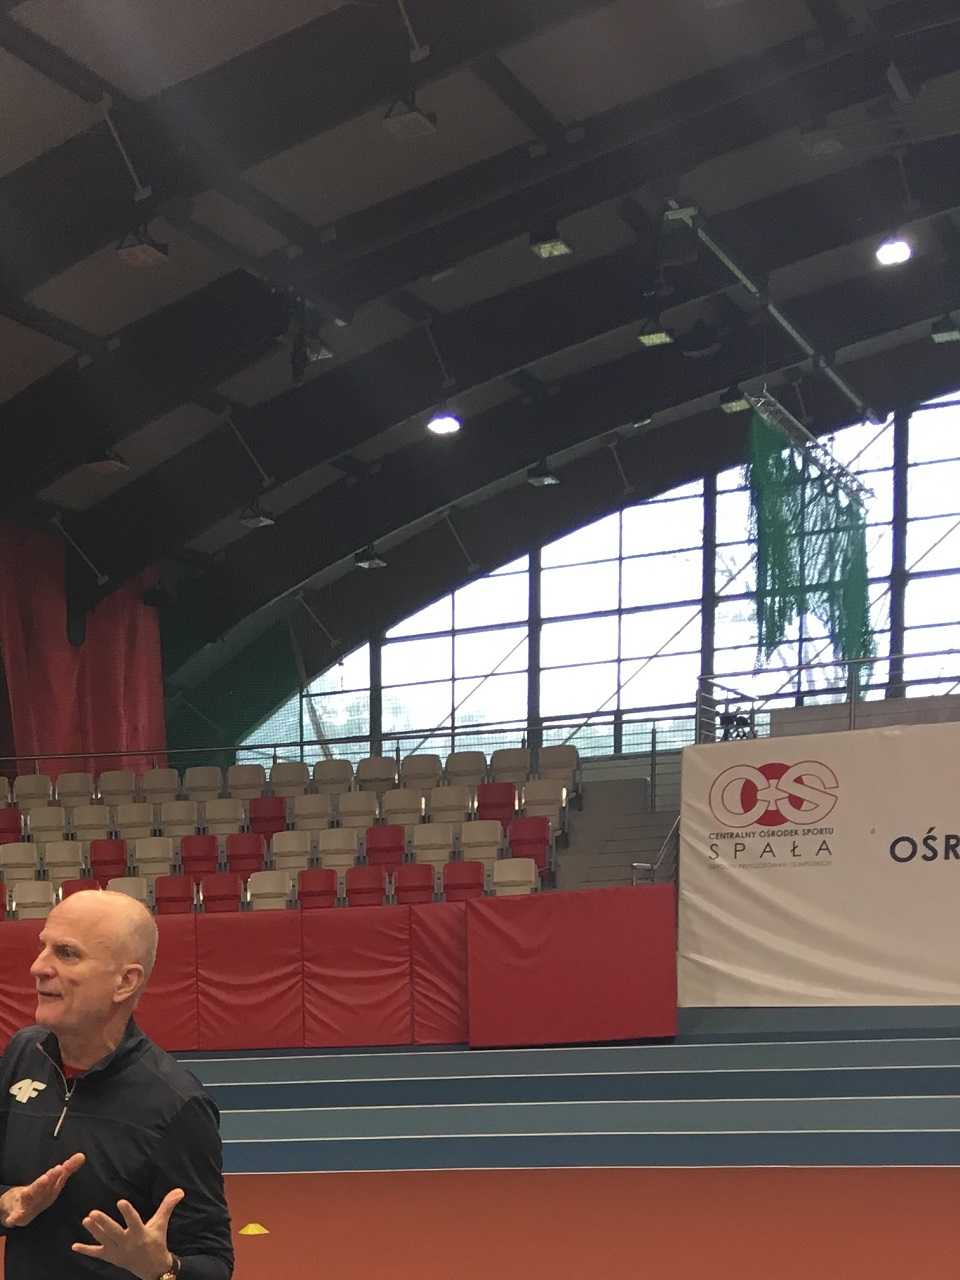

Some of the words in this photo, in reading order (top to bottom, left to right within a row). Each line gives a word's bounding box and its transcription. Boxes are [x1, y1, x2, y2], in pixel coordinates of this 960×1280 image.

[708, 831, 756, 840] CENTRALNY
[802, 827, 834, 836] SPORTU
[9, 1078, 47, 1104] 4F
